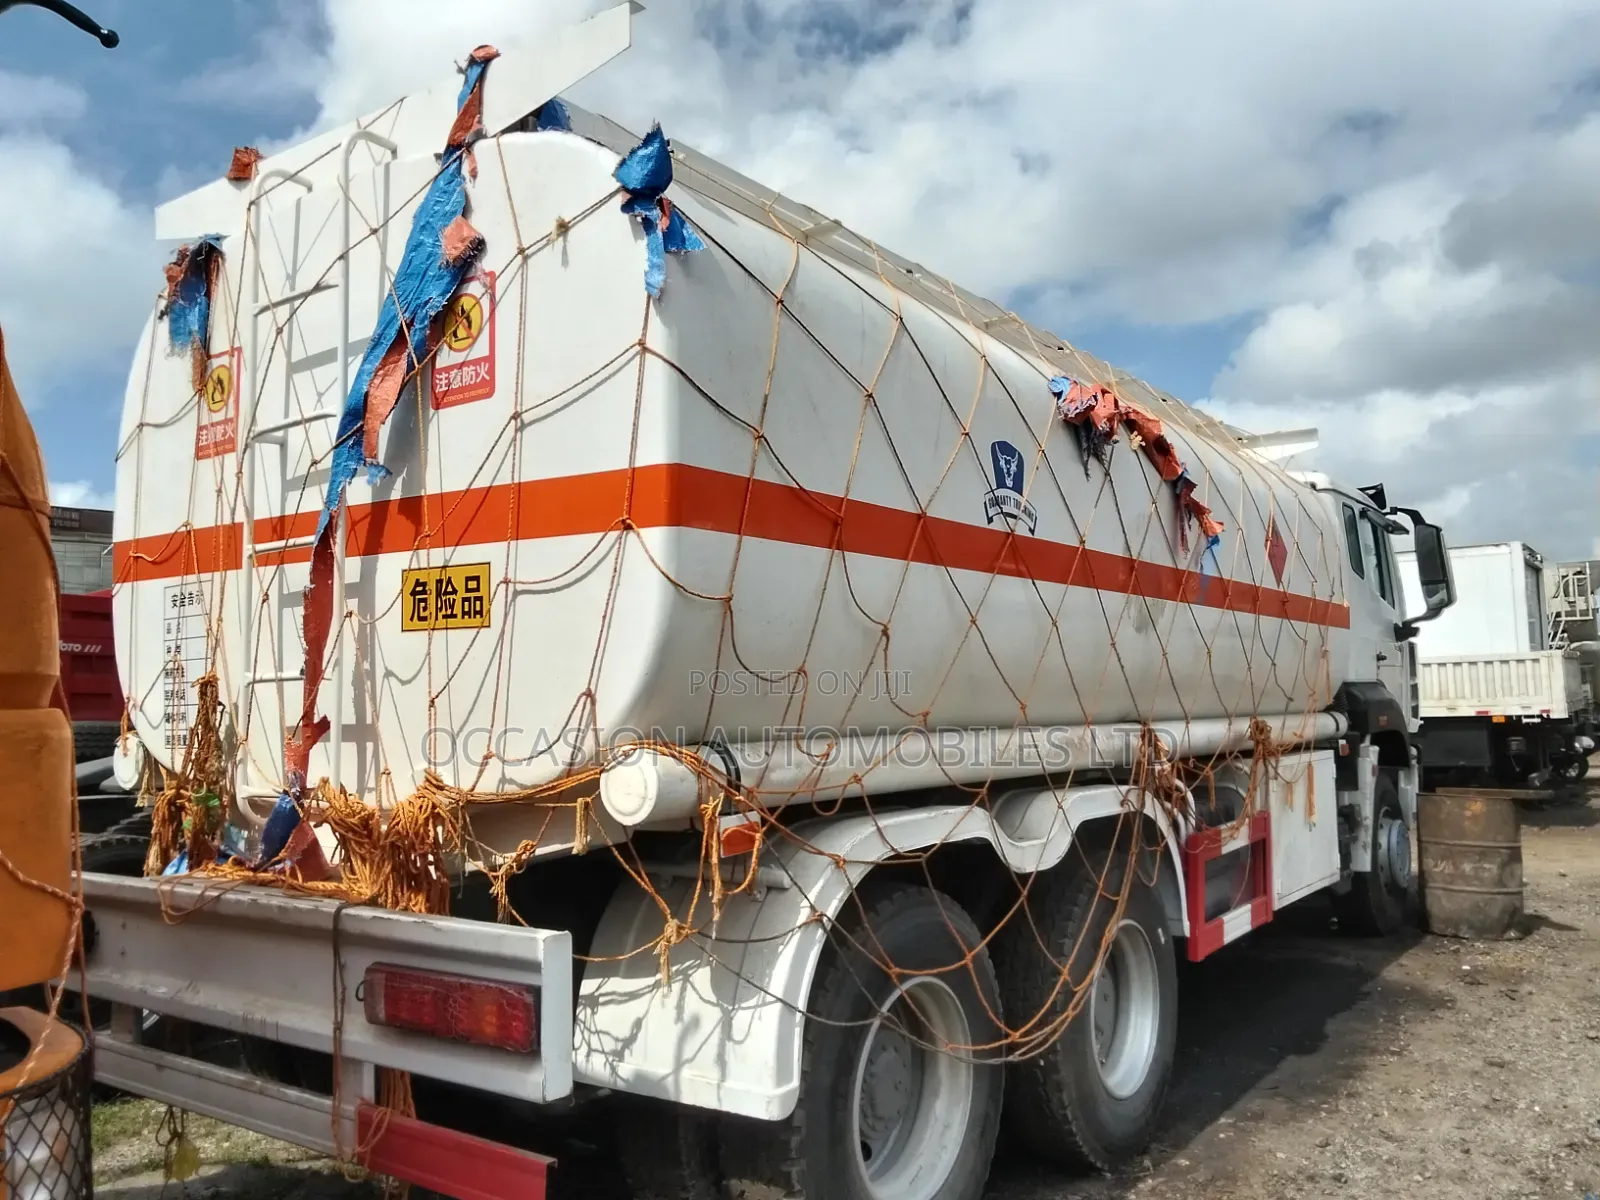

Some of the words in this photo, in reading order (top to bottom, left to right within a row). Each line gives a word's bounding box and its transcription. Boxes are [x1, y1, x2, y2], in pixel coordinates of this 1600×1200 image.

[435, 361, 490, 393] 注意防火
[409, 575, 484, 622] 危险品
